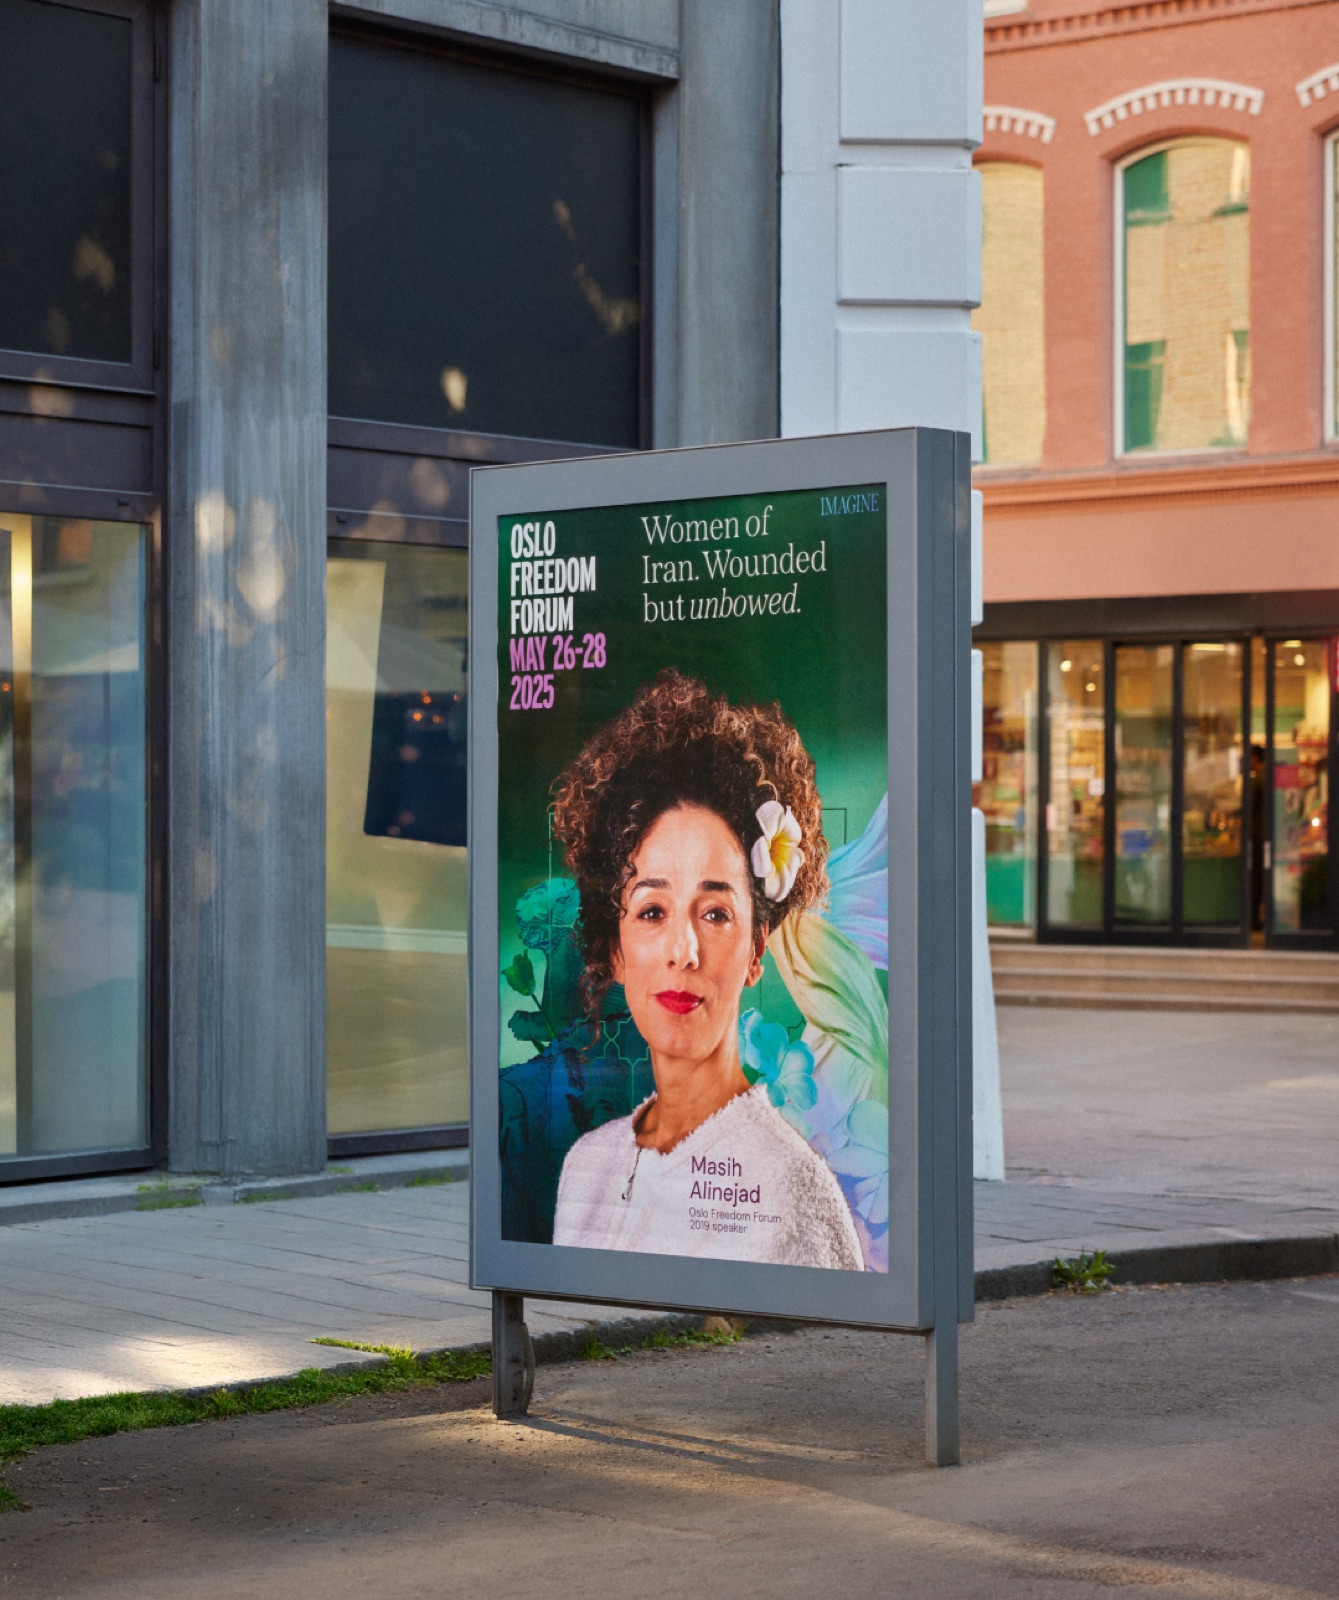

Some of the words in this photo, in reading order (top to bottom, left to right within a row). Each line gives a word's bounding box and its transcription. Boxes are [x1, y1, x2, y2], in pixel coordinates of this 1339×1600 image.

[819, 492, 879, 516] IMAGINE
[510, 520, 556, 559] OSLO
[641, 514, 740, 546] Women
[745, 505, 773, 537] of
[510, 556, 597, 597] FREEDOM
[642, 554, 700, 585] Iran.
[702, 540, 827, 580] Wounded
[510, 597, 574, 634] FORUM
[643, 592, 687, 623] but
[690, 583, 802, 620] unbowed.
[510, 635, 548, 672] MAY
[552, 632, 607, 671] 26-28
[509, 674, 555, 710] 2025
[691, 1155, 742, 1177] Masih
[689, 1181, 761, 1207] Alinejad
[689, 1206, 709, 1218] Oslo
[711, 1208, 751, 1222] Freedom
[753, 1211, 782, 1224] Forum
[690, 1218, 710, 1231] 2019
[712, 1222, 747, 1234] speaker
